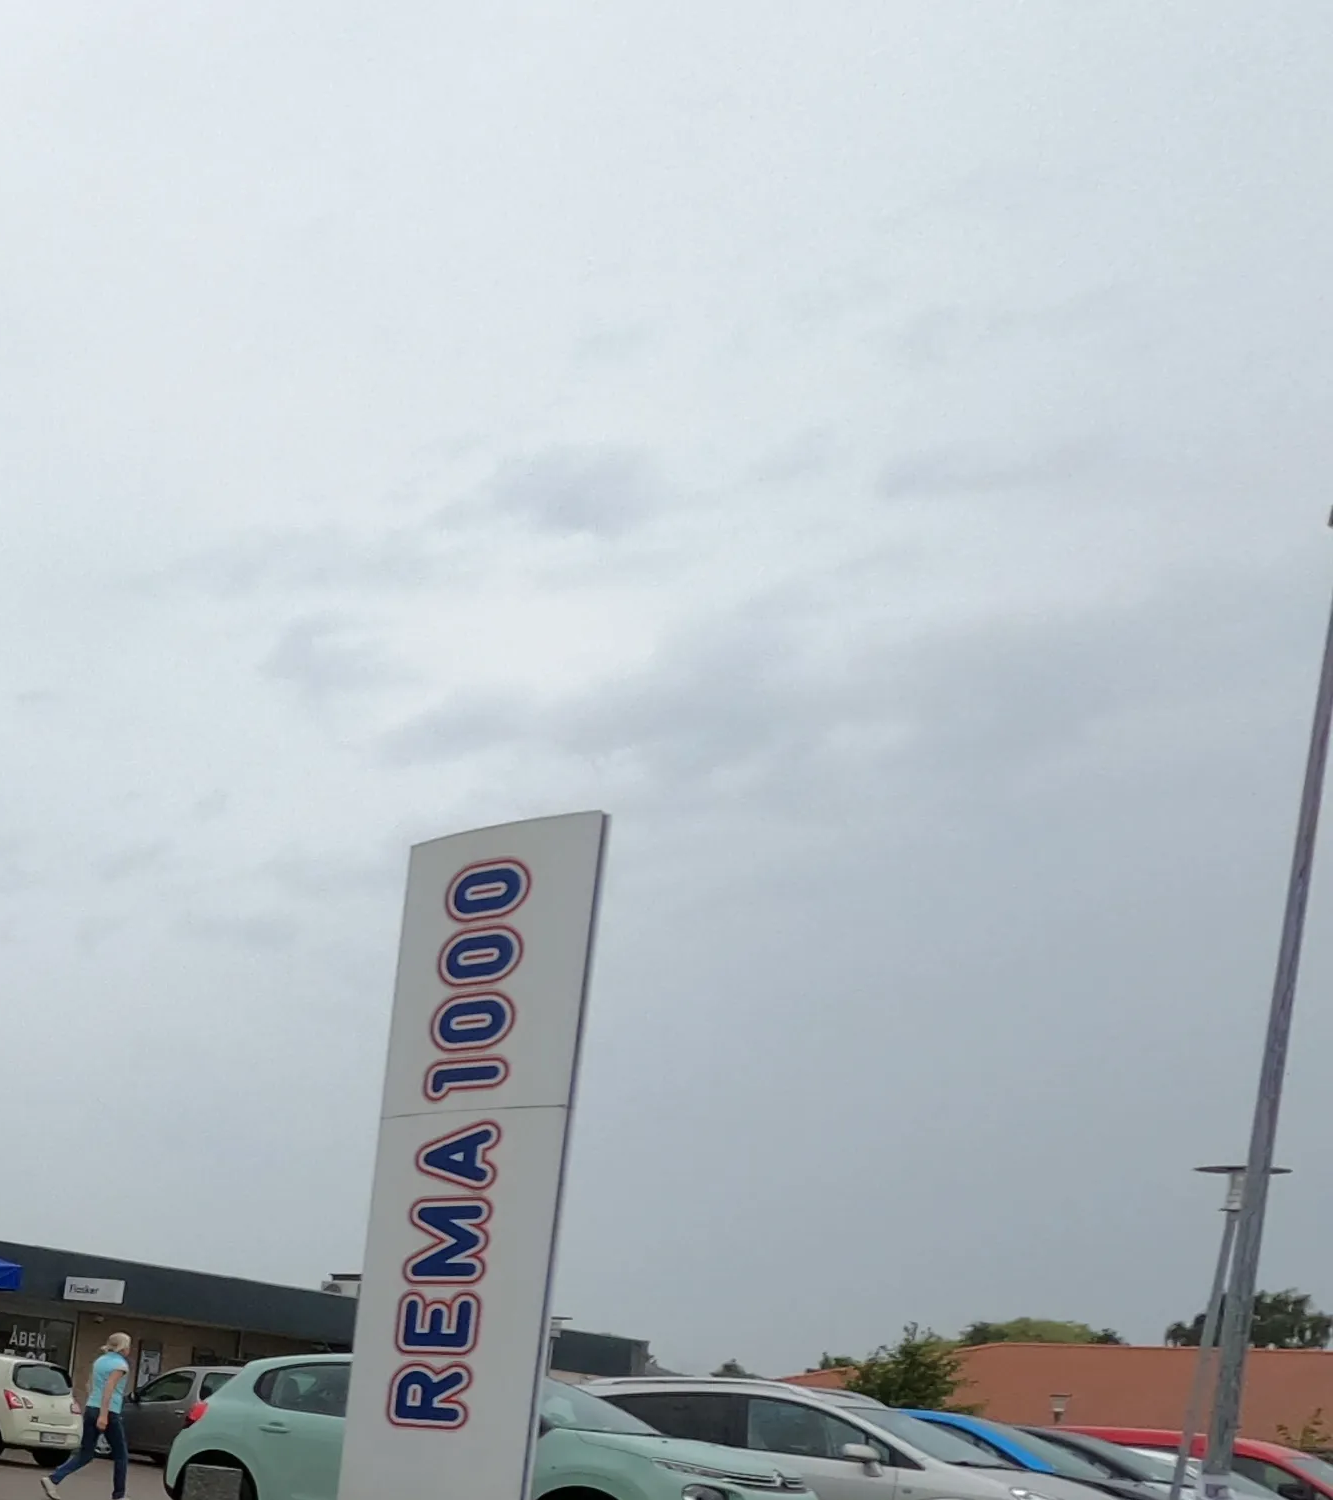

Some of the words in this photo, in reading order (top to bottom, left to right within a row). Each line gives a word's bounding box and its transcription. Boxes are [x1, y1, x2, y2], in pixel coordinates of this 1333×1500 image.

[423, 857, 531, 1103] 1000
[8, 1324, 46, 1348] ÅBEN
[387, 1119, 501, 1430] REMA
